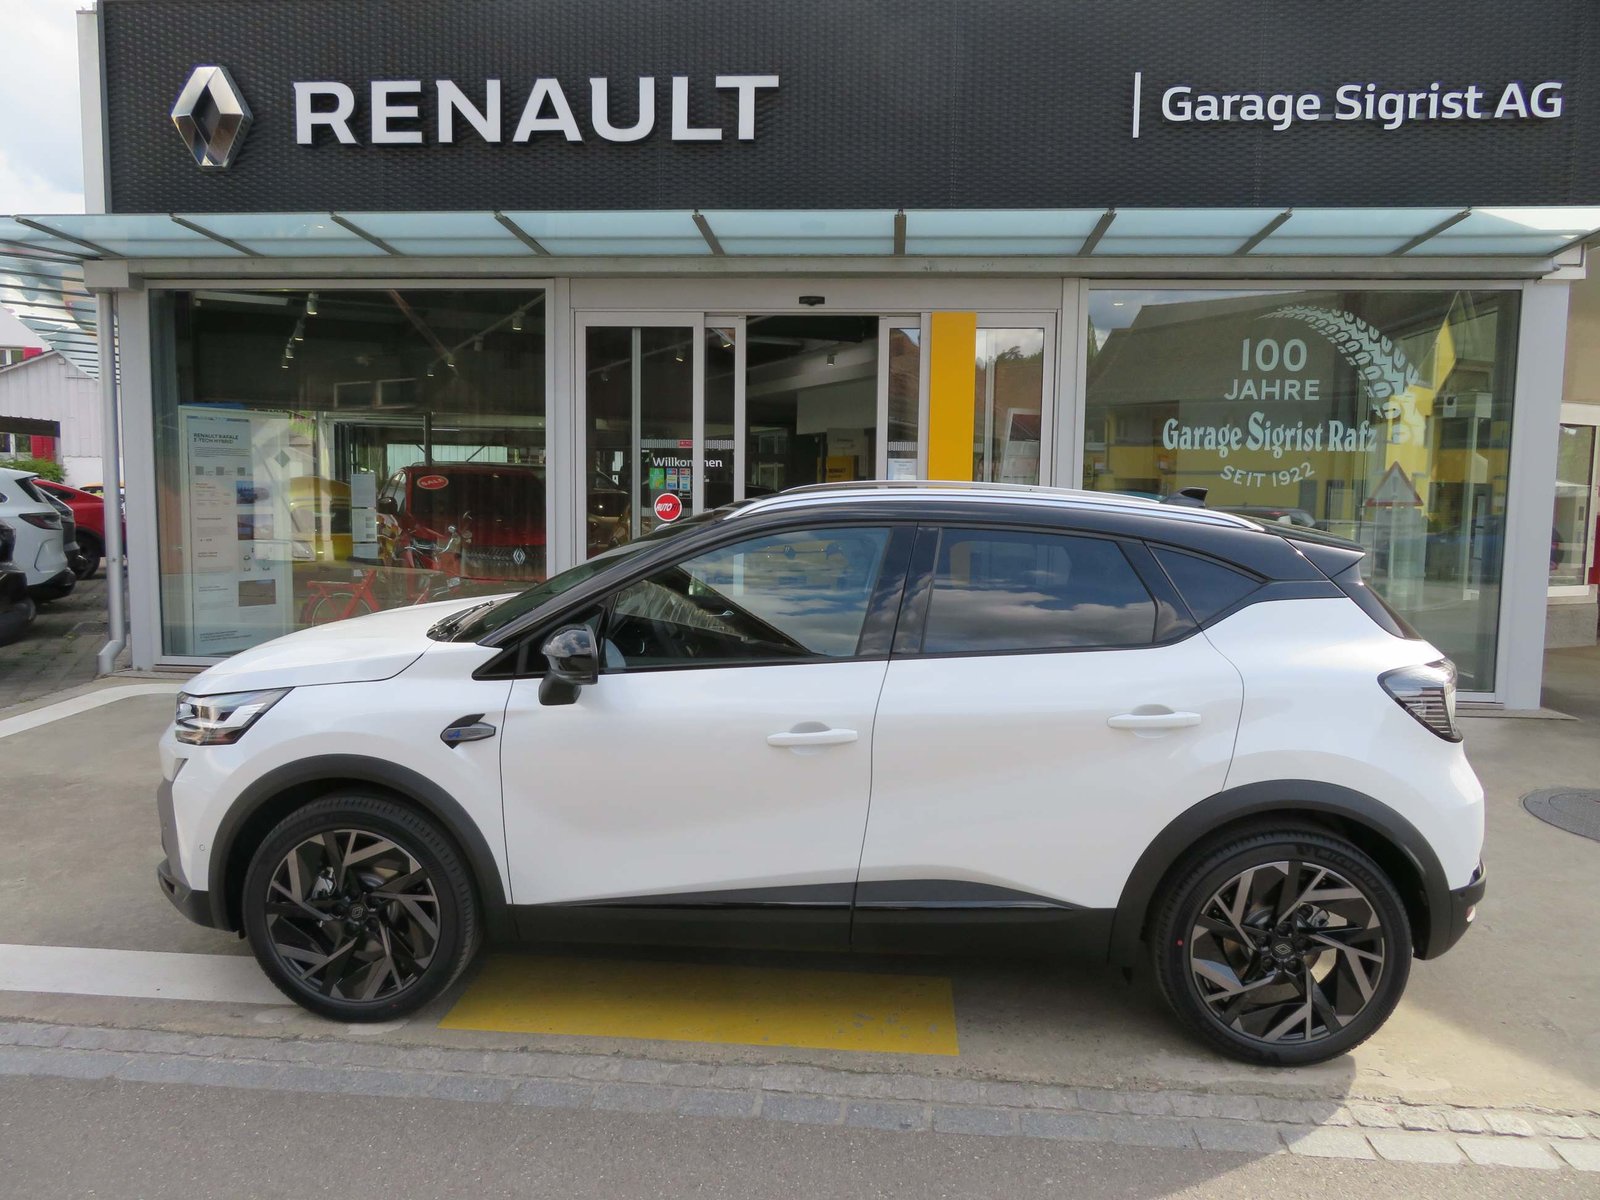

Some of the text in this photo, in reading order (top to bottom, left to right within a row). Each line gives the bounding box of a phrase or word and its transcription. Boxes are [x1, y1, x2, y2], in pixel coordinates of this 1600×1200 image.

[293, 75, 779, 144] RENAULT
[1161, 81, 1563, 131] Garage Sigrist AG
[1241, 338, 1308, 372] 100
[1224, 379, 1321, 401] JAHRE
[1162, 411, 1377, 459] Garage Sigrist Rafz
[1220, 461, 1315, 488] SEIT 1922
